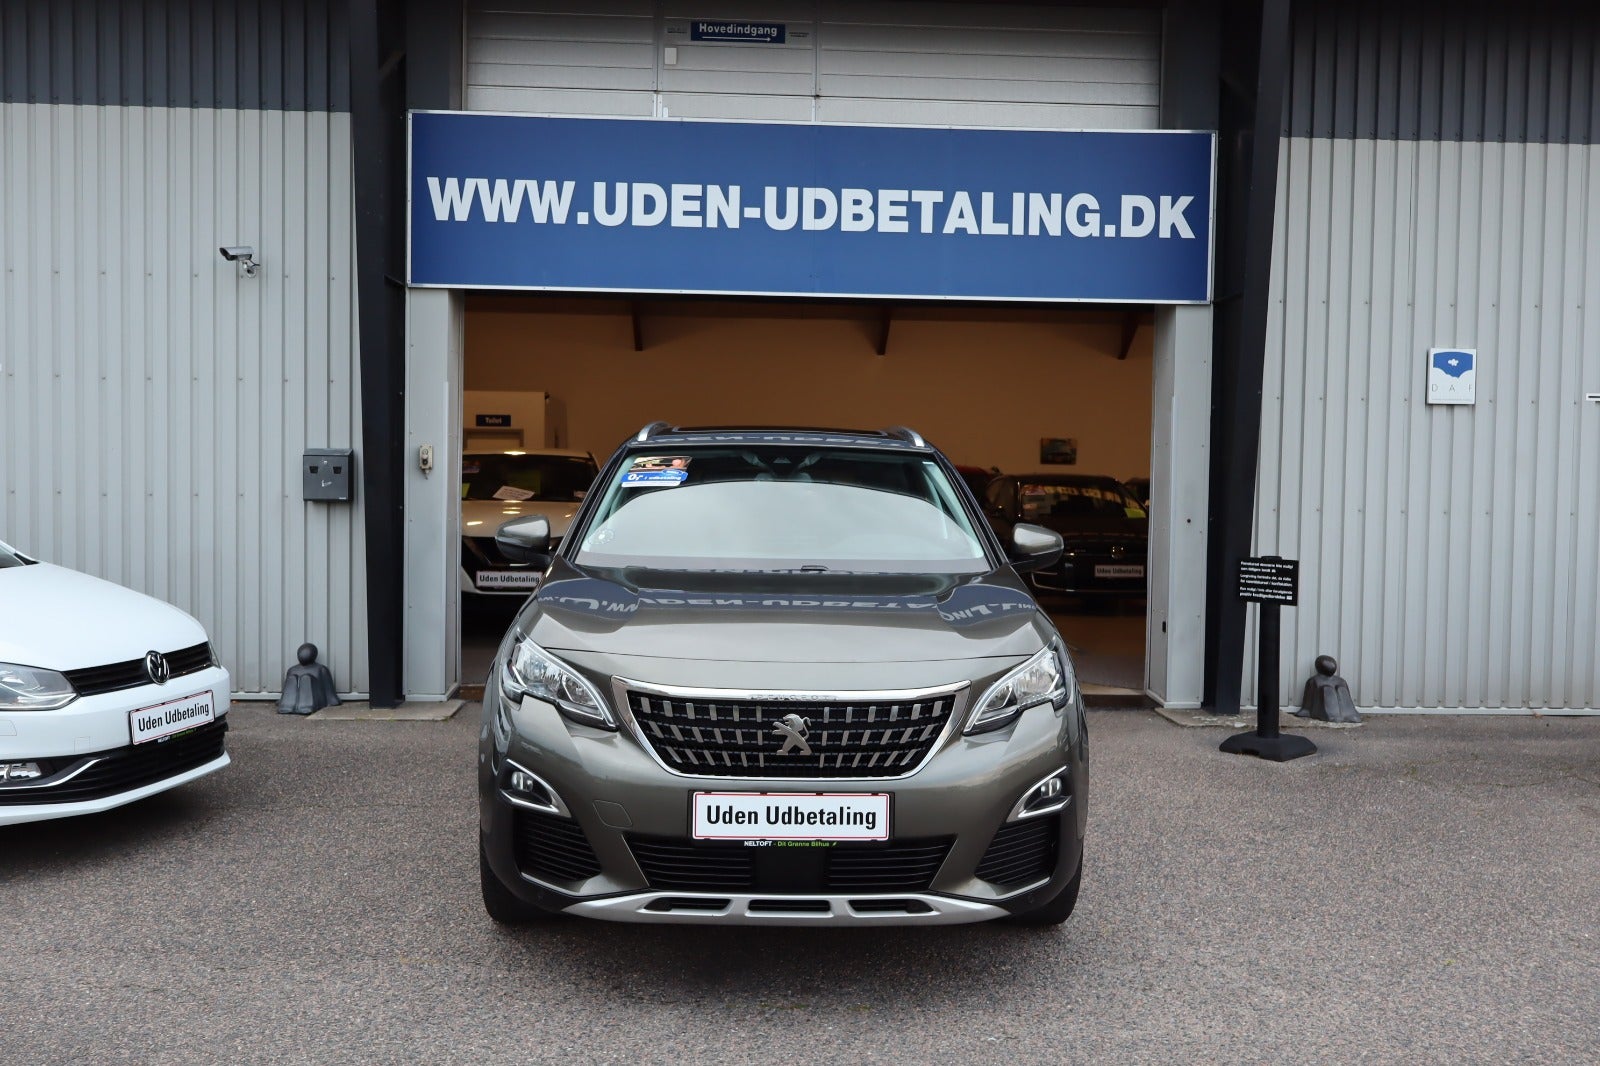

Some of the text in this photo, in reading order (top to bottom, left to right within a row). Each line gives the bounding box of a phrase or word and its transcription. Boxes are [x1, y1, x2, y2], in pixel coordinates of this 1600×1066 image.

[699, 23, 778, 37] Hovedindgang
[426, 176, 1196, 239] WWW.UDEN-UDBETALING.DK
[479, 574, 540, 585] Uden Udbetaling
[138, 703, 209, 732] Uden Udbetaling
[706, 804, 877, 830] Uden Udbetaling
